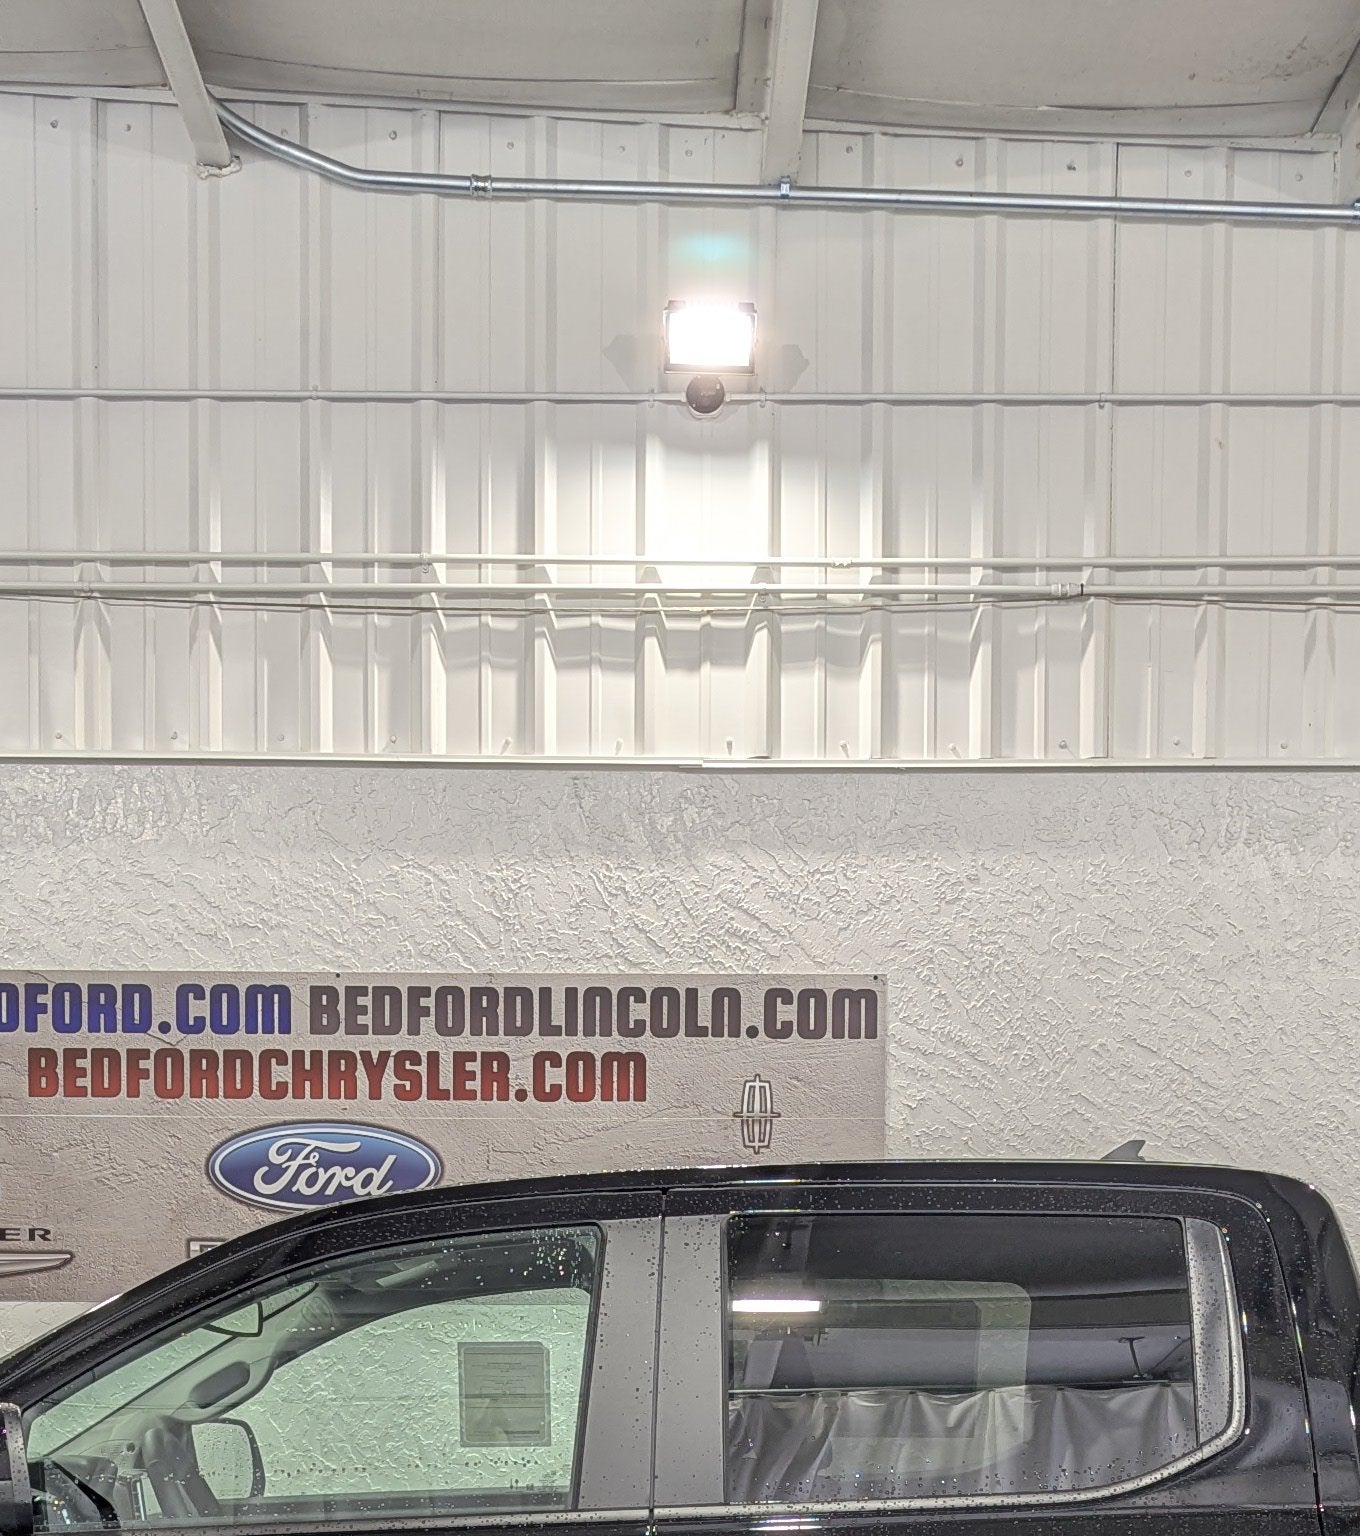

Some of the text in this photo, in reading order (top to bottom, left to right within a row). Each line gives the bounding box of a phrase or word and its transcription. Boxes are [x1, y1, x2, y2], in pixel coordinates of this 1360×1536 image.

[309, 985, 878, 1039] BEDFORDLINCOLN.COM
[27, 1047, 647, 1102] BEDFORDCHRYSLER.COM
[253, 1137, 398, 1196] Ford
